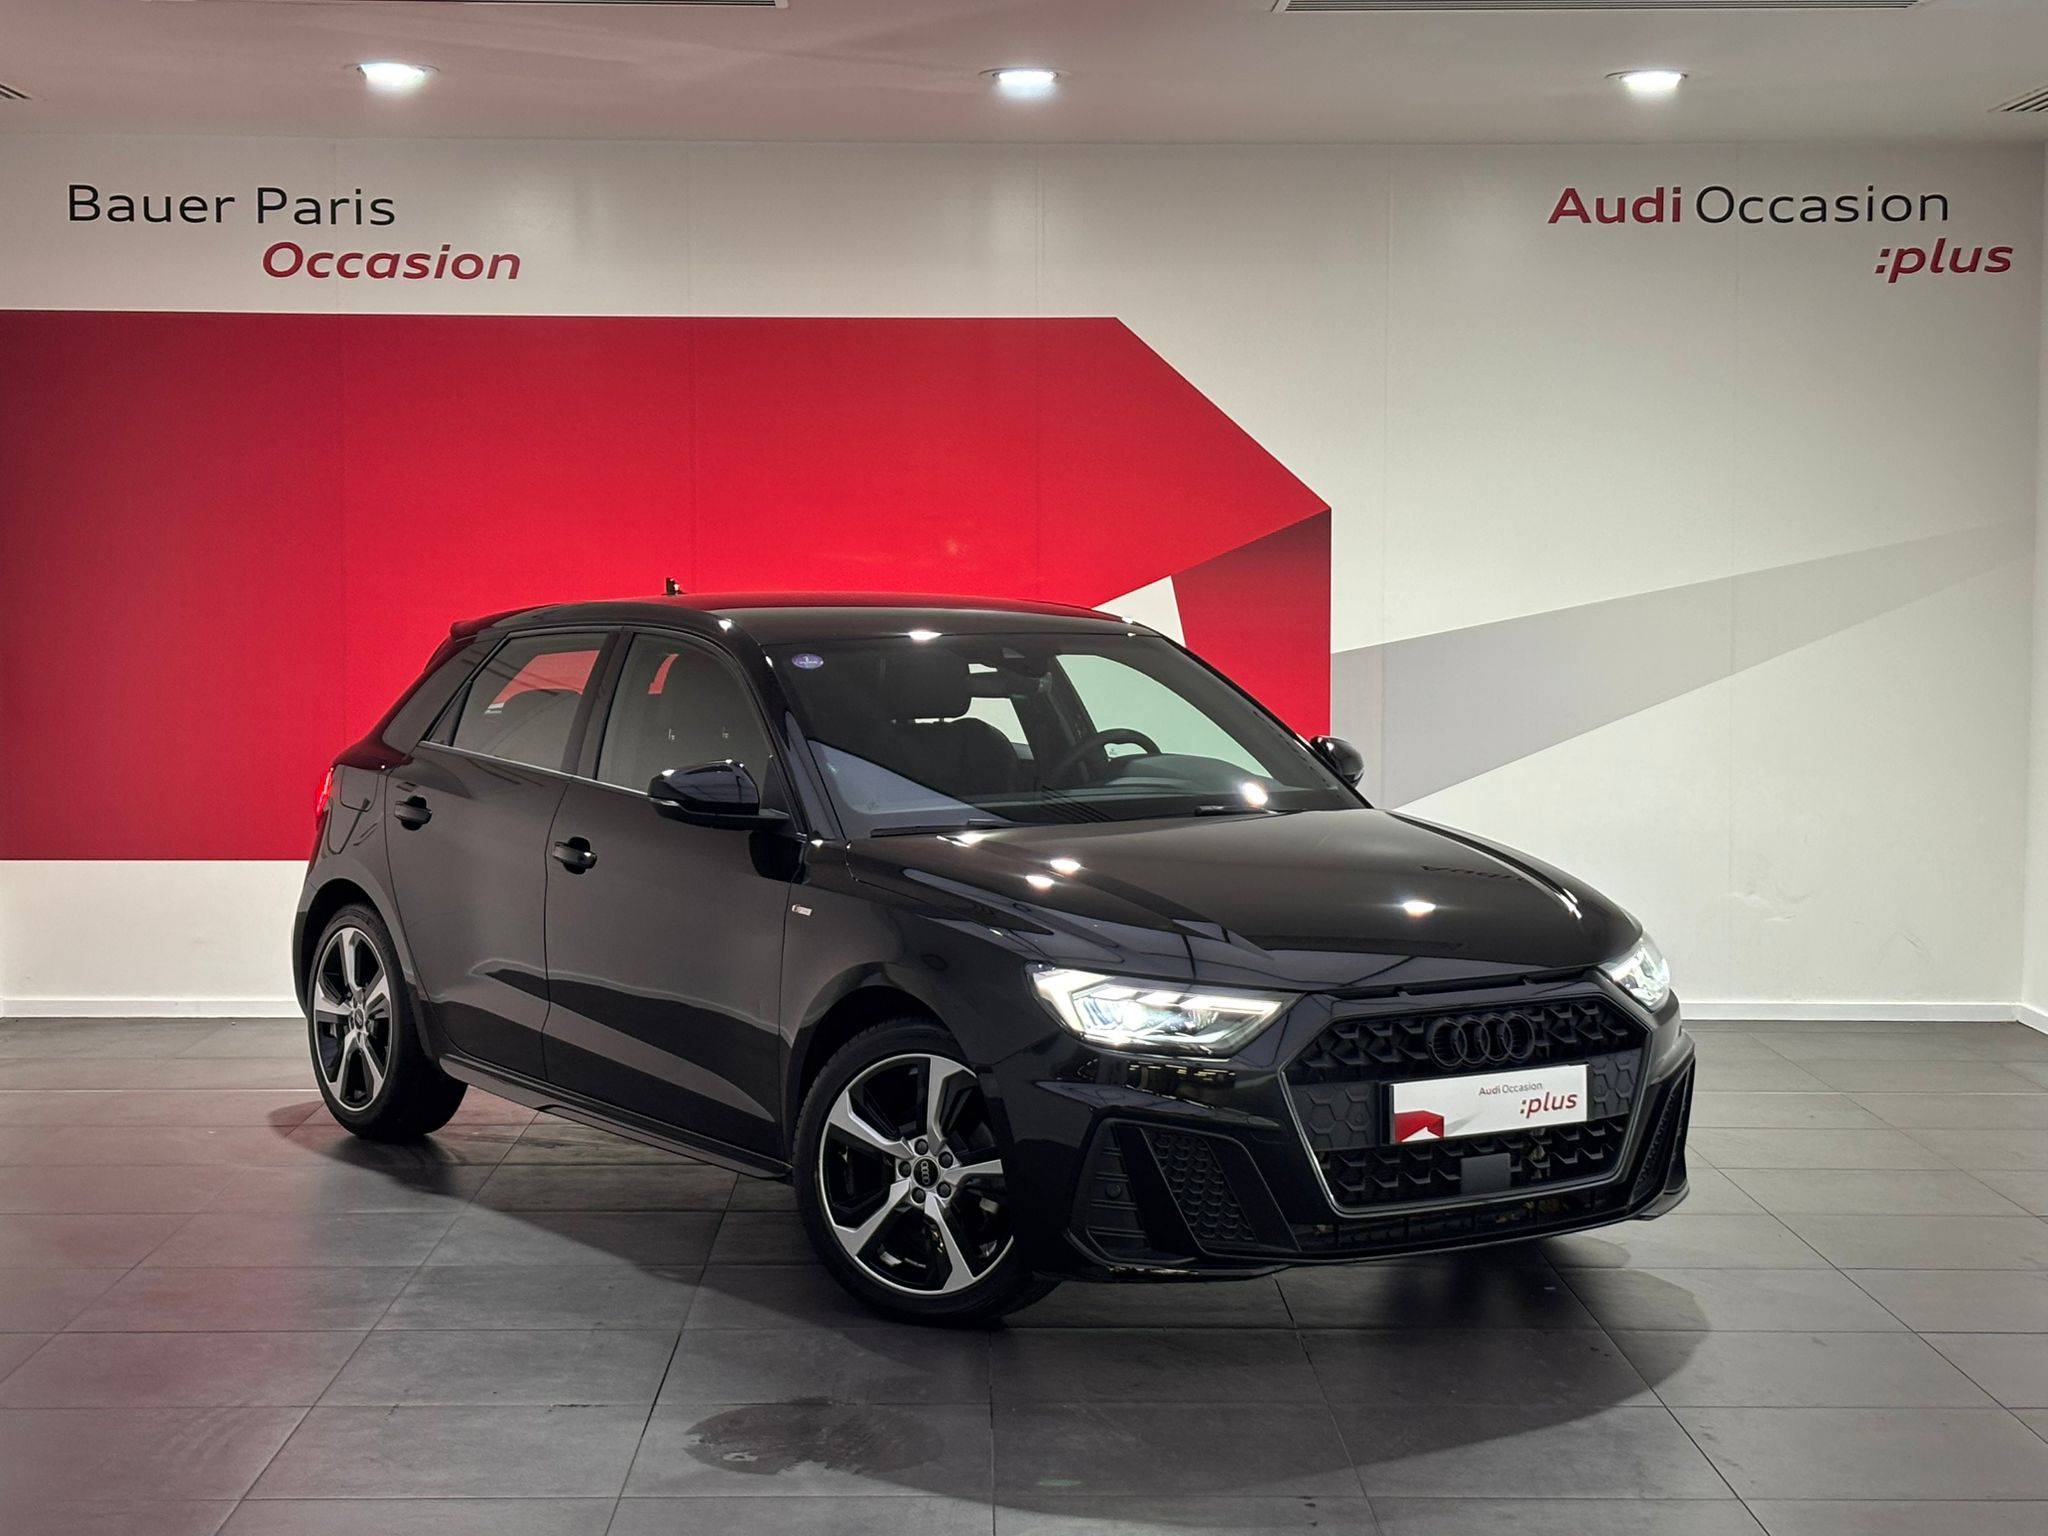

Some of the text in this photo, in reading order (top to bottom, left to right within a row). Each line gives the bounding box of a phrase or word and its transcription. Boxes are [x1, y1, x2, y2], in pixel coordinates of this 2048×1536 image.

[69, 185, 395, 225] Bauer Paris
[1548, 185, 1949, 225] Audi Occasion
[263, 241, 521, 280] Occasion
[1875, 238, 2014, 284] :plus
[1478, 1081, 1543, 1096] Audi Occasion
[1519, 1091, 1578, 1119] :plus
